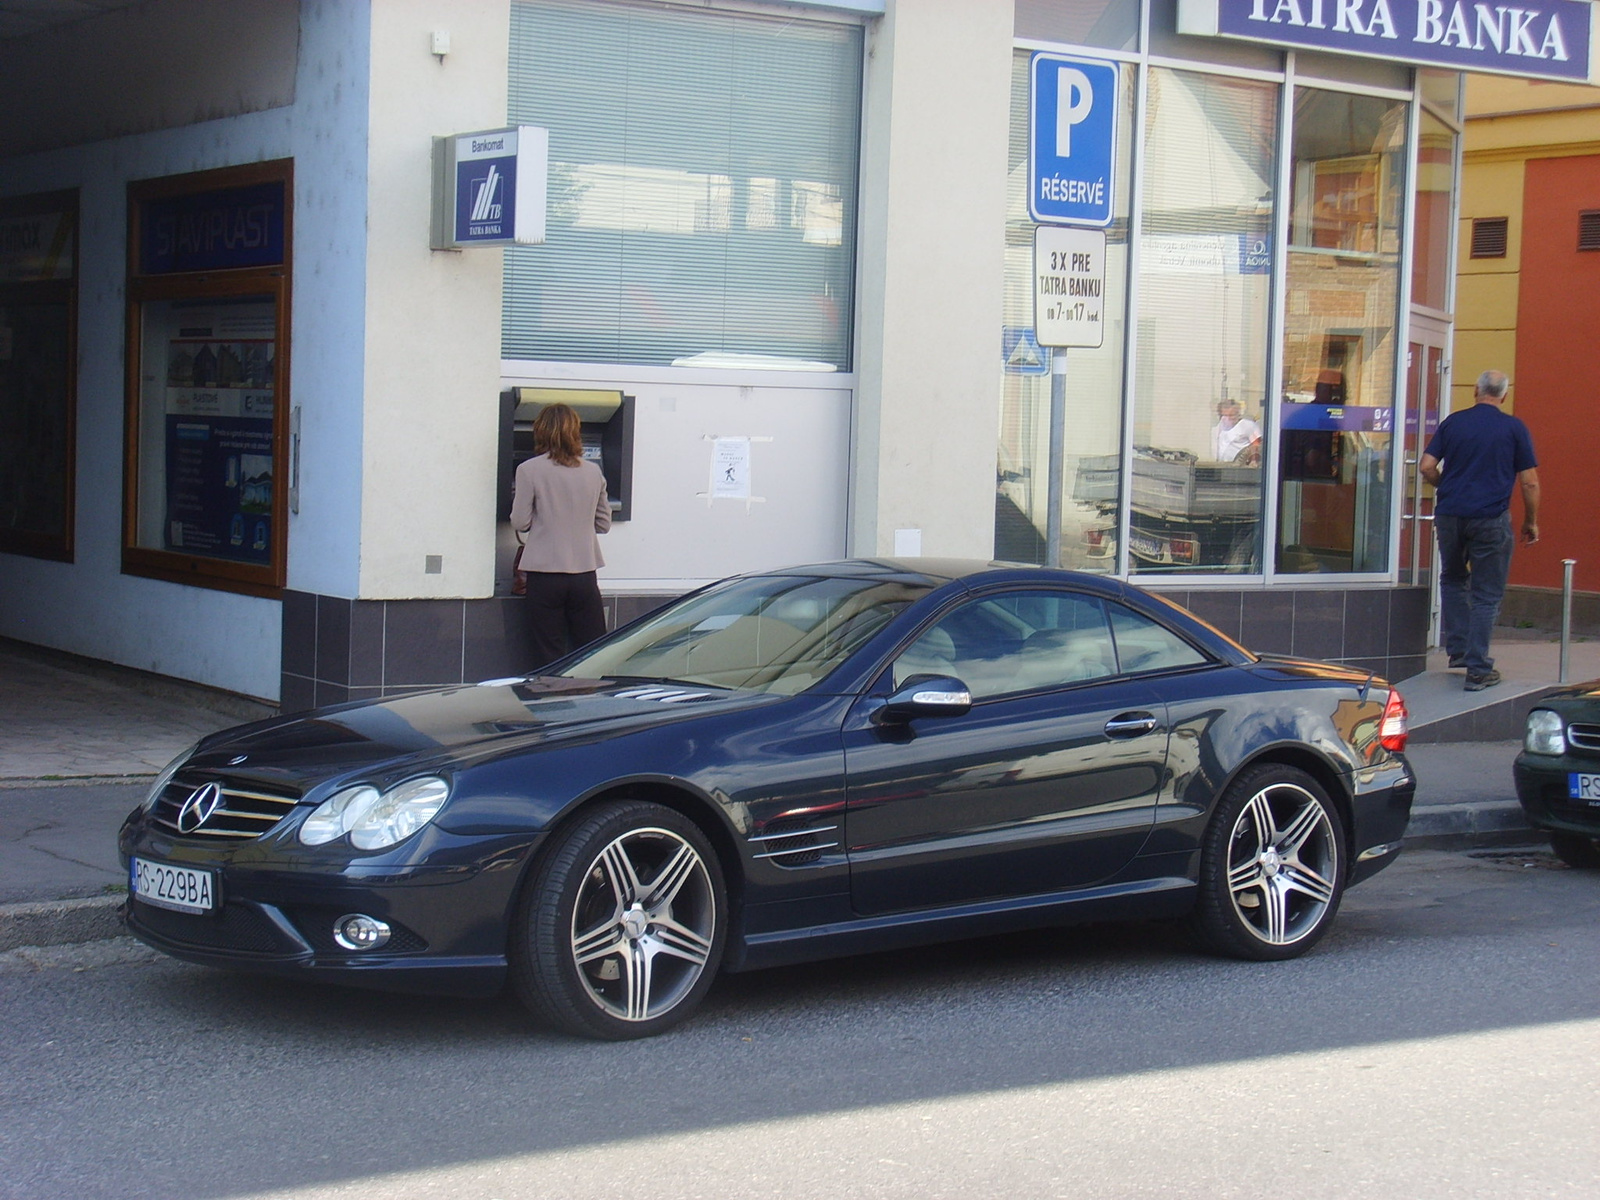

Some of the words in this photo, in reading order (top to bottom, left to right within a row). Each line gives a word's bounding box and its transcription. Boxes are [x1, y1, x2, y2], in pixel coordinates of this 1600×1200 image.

[1247, 0, 1399, 39] TATRA
[1412, 0, 1572, 62] BANKA
[1055, 66, 1094, 158] P
[472, 137, 504, 153] Bankomat
[1041, 172, 1104, 206] RÉSERVÉ
[489, 204, 502, 220] TB
[156, 203, 274, 259] STAVIPLAST
[469, 225, 485, 236] TATRA
[485, 224, 502, 235] BANKA
[1051, 251, 1057, 271] 3
[1060, 252, 1067, 271] X
[1071, 252, 1091, 272] PRE
[1040, 276, 1067, 296] TATRA
[1069, 277, 1101, 298] BANKU
[136, 861, 210, 905] RS-229BA
